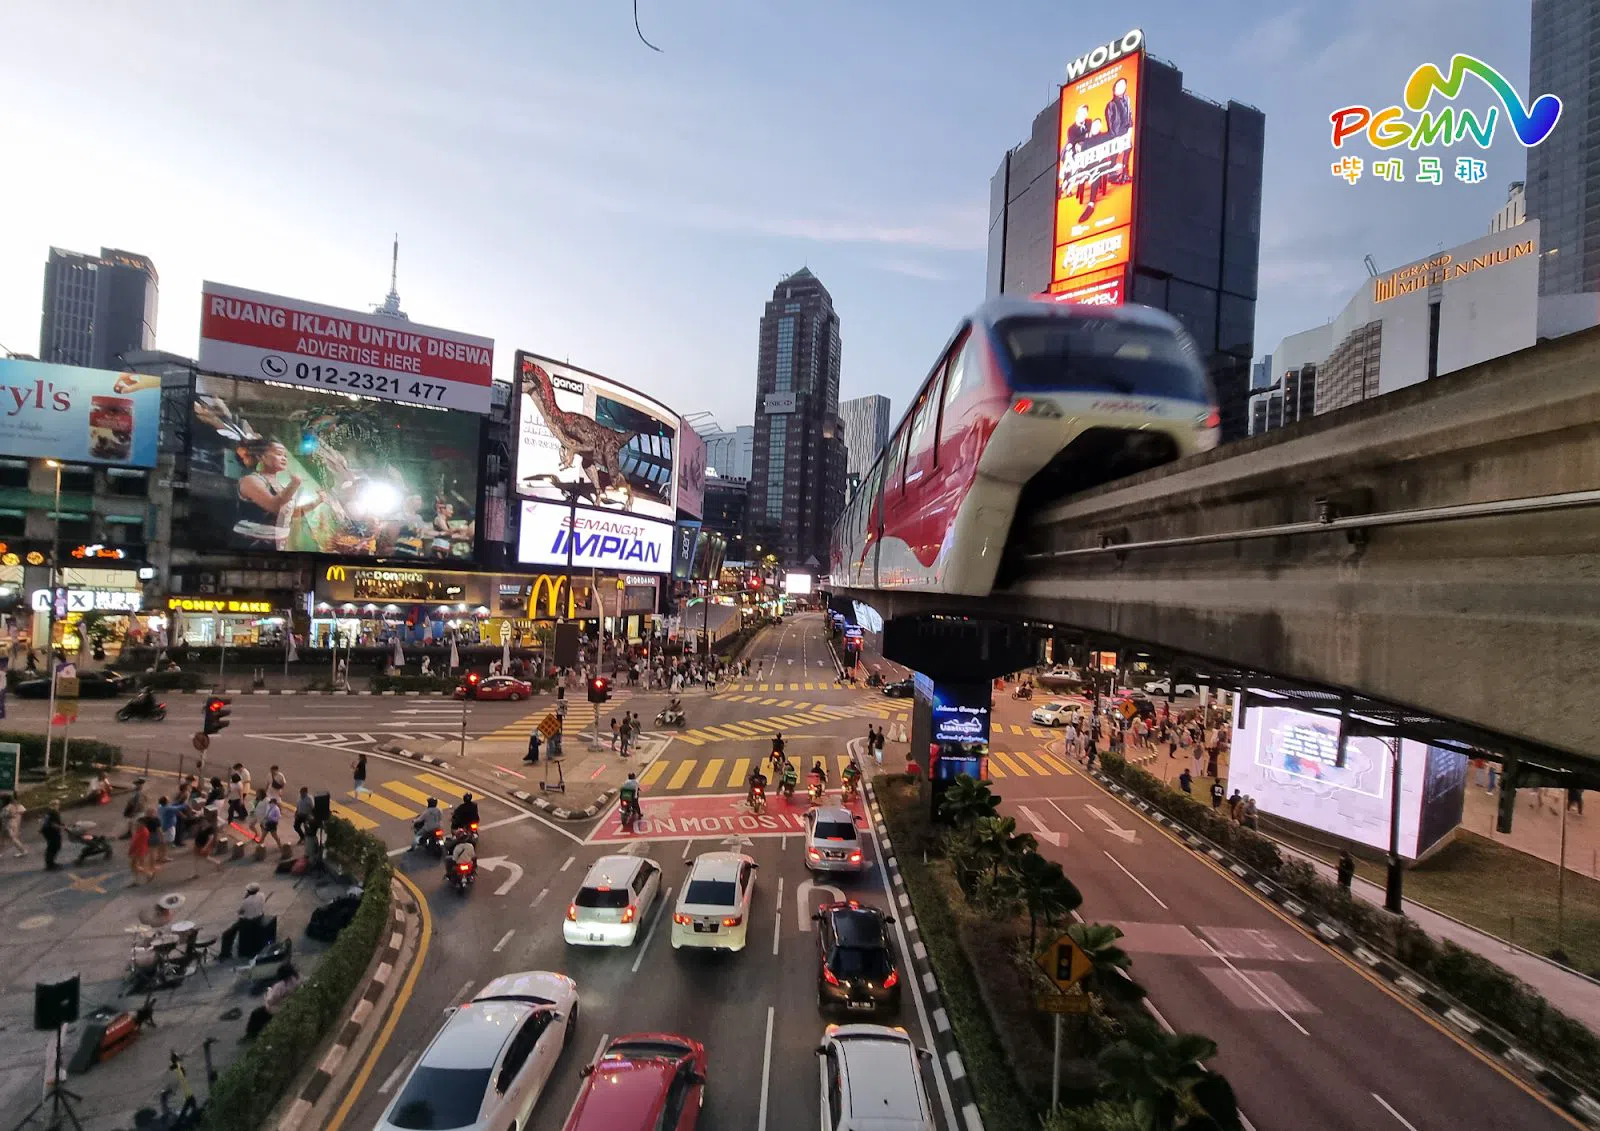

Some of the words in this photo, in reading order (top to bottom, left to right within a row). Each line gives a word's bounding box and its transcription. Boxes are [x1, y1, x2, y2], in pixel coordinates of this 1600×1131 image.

[1067, 29, 1142, 79] WOLO
[1399, 255, 1452, 279] GRAND
[1400, 240, 1534, 296] MILLENNIUM
[211, 297, 286, 328] RUANG
[292, 313, 352, 340] IKLAN
[357, 325, 422, 353] UNTUK
[427, 340, 491, 366] DISEWA
[296, 337, 380, 365] ADVERTISE
[384, 353, 421, 373] HERE
[0, 379, 71, 416] yl's
[296, 362, 399, 394] 012-2321
[408, 381, 447, 401] 477
[553, 376, 583, 393] ganad
[560, 515, 645, 537] SEMANGAT
[550, 529, 662, 563] IMPIAN
[682, 534, 690, 560] acer
[626, 576, 656, 585] GIORDANO
